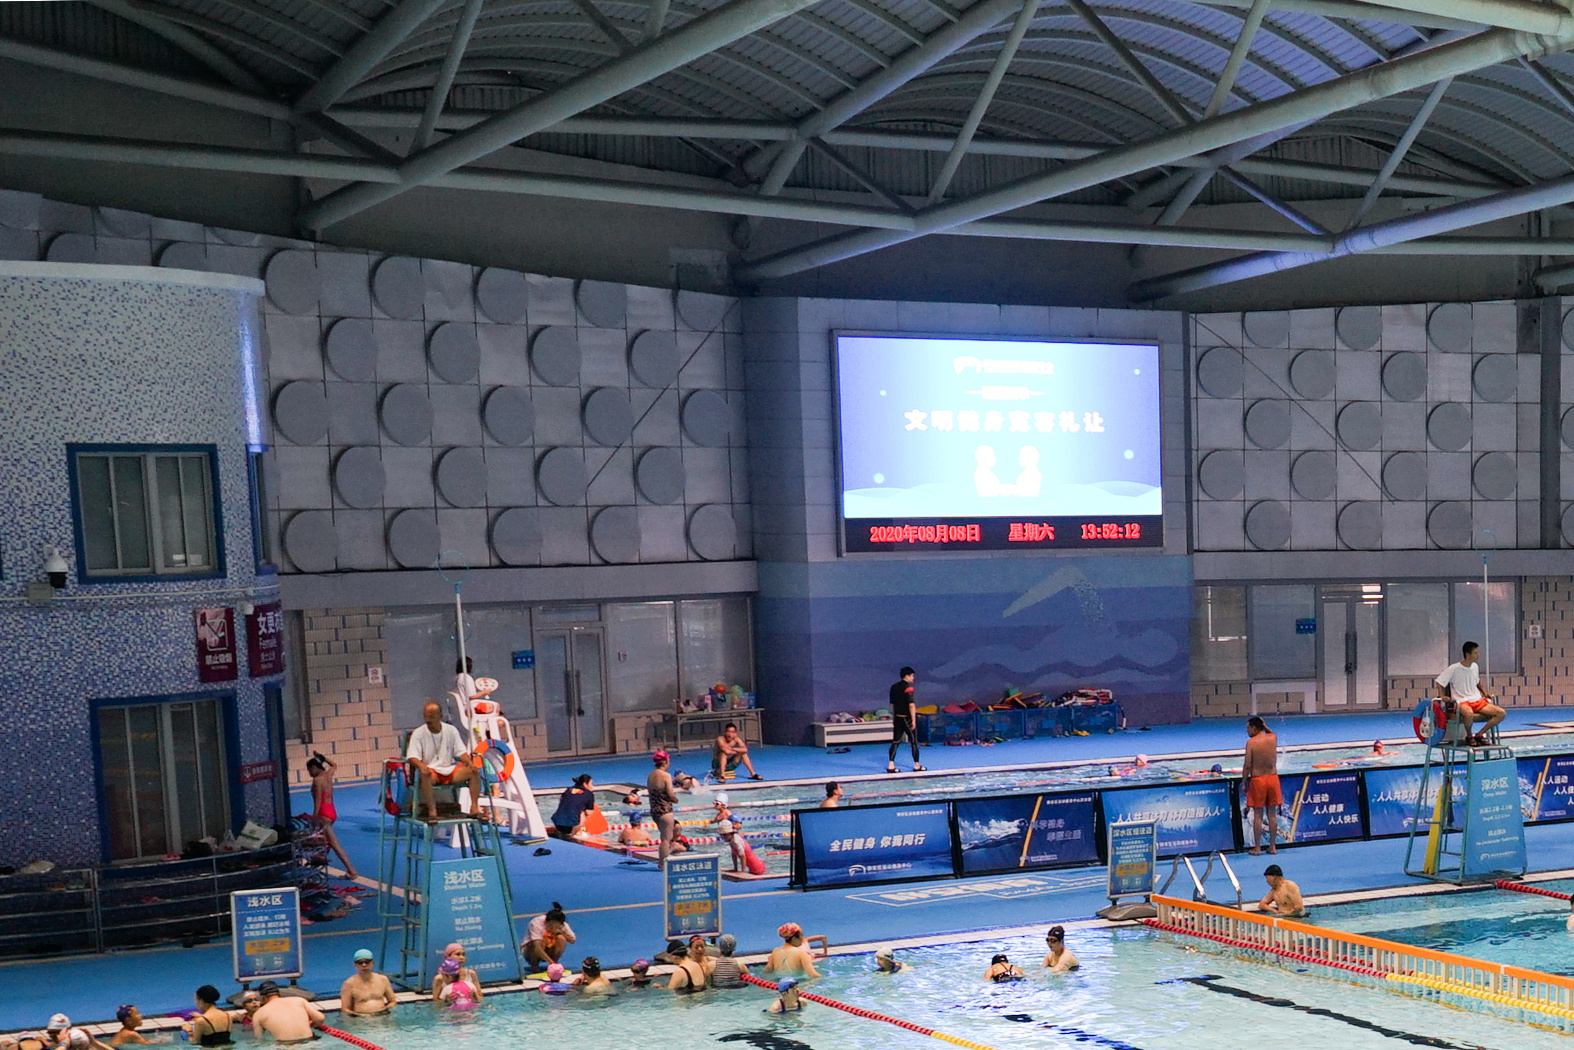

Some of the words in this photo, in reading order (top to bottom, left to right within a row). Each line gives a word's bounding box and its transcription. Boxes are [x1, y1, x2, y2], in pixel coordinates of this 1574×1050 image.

[870, 524, 981, 543] 2020年08月08日
[1008, 523, 1055, 541] 星期六
[1081, 523, 1141, 539] 13:52:12
[1481, 777, 1508, 791] 深水区
[1313, 803, 1344, 815] 人人健康
[1329, 814, 1359, 825] 人人快乐
[829, 837, 875, 852] 全民健身
[880, 833, 926, 848] 你我同行
[444, 869, 485, 885] 浅水区
[247, 894, 283, 907] 浅水区
